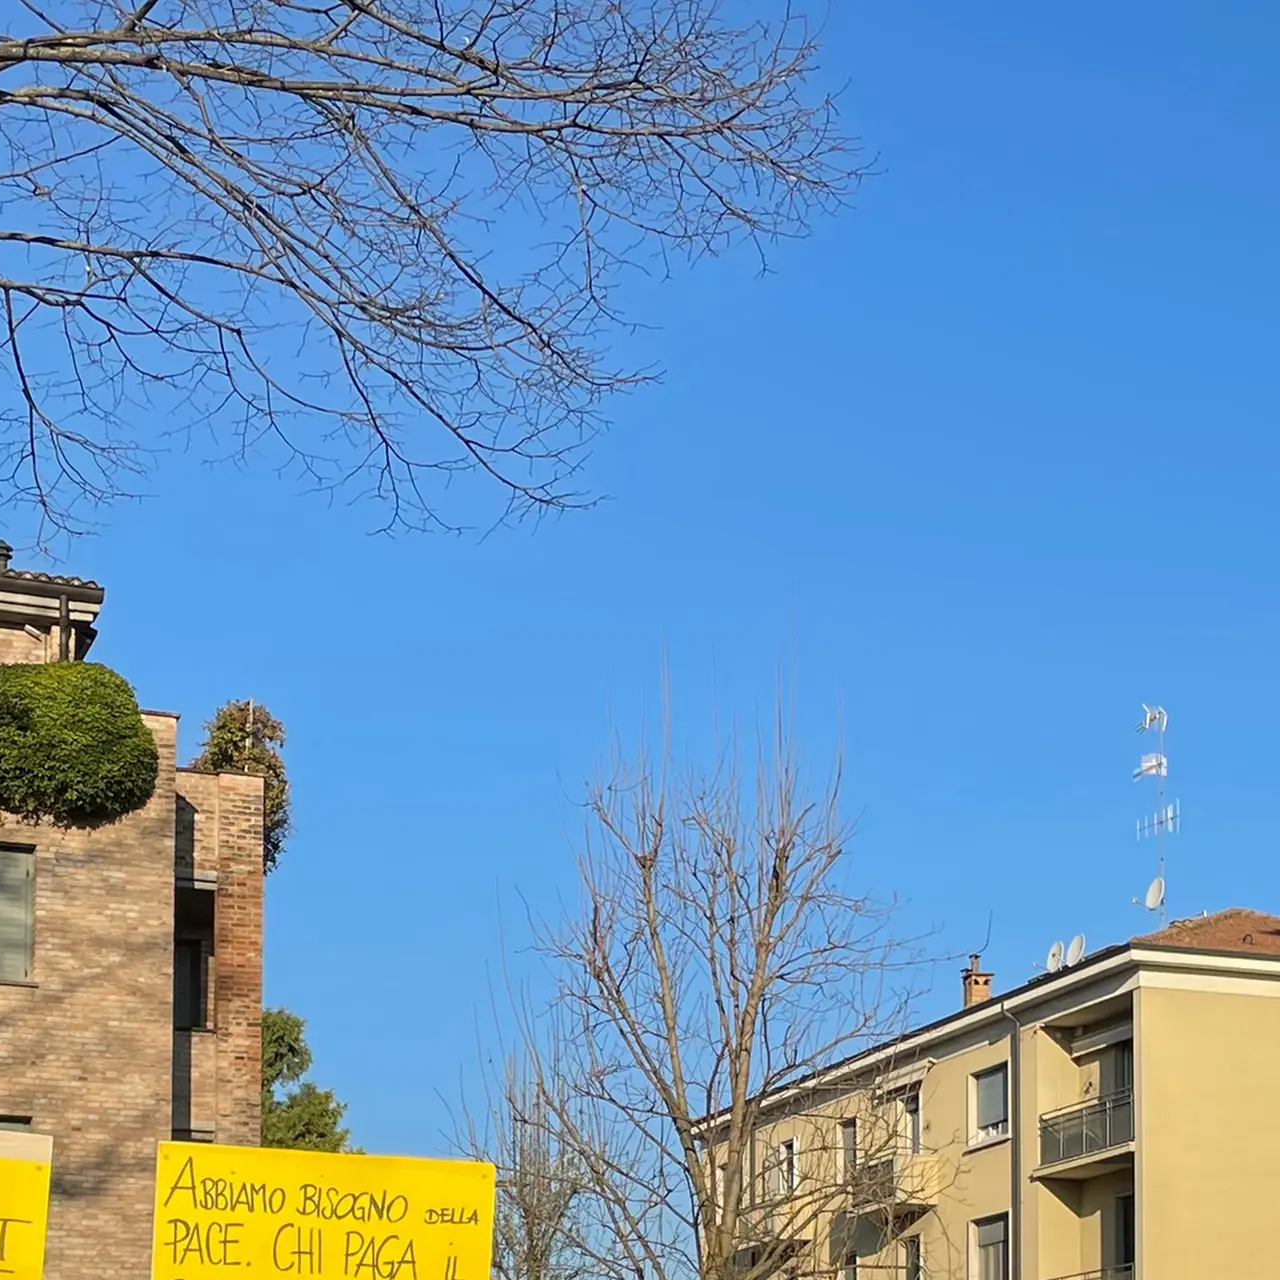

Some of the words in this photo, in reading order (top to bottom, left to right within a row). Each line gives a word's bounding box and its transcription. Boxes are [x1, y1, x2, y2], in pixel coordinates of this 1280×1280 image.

[165, 1156, 286, 1215] ABBIAMO
[296, 1183, 408, 1224] BISOGNO
[424, 1207, 480, 1226] DELLA
[164, 1219, 252, 1268] PACE.
[272, 1223, 322, 1275] CHI
